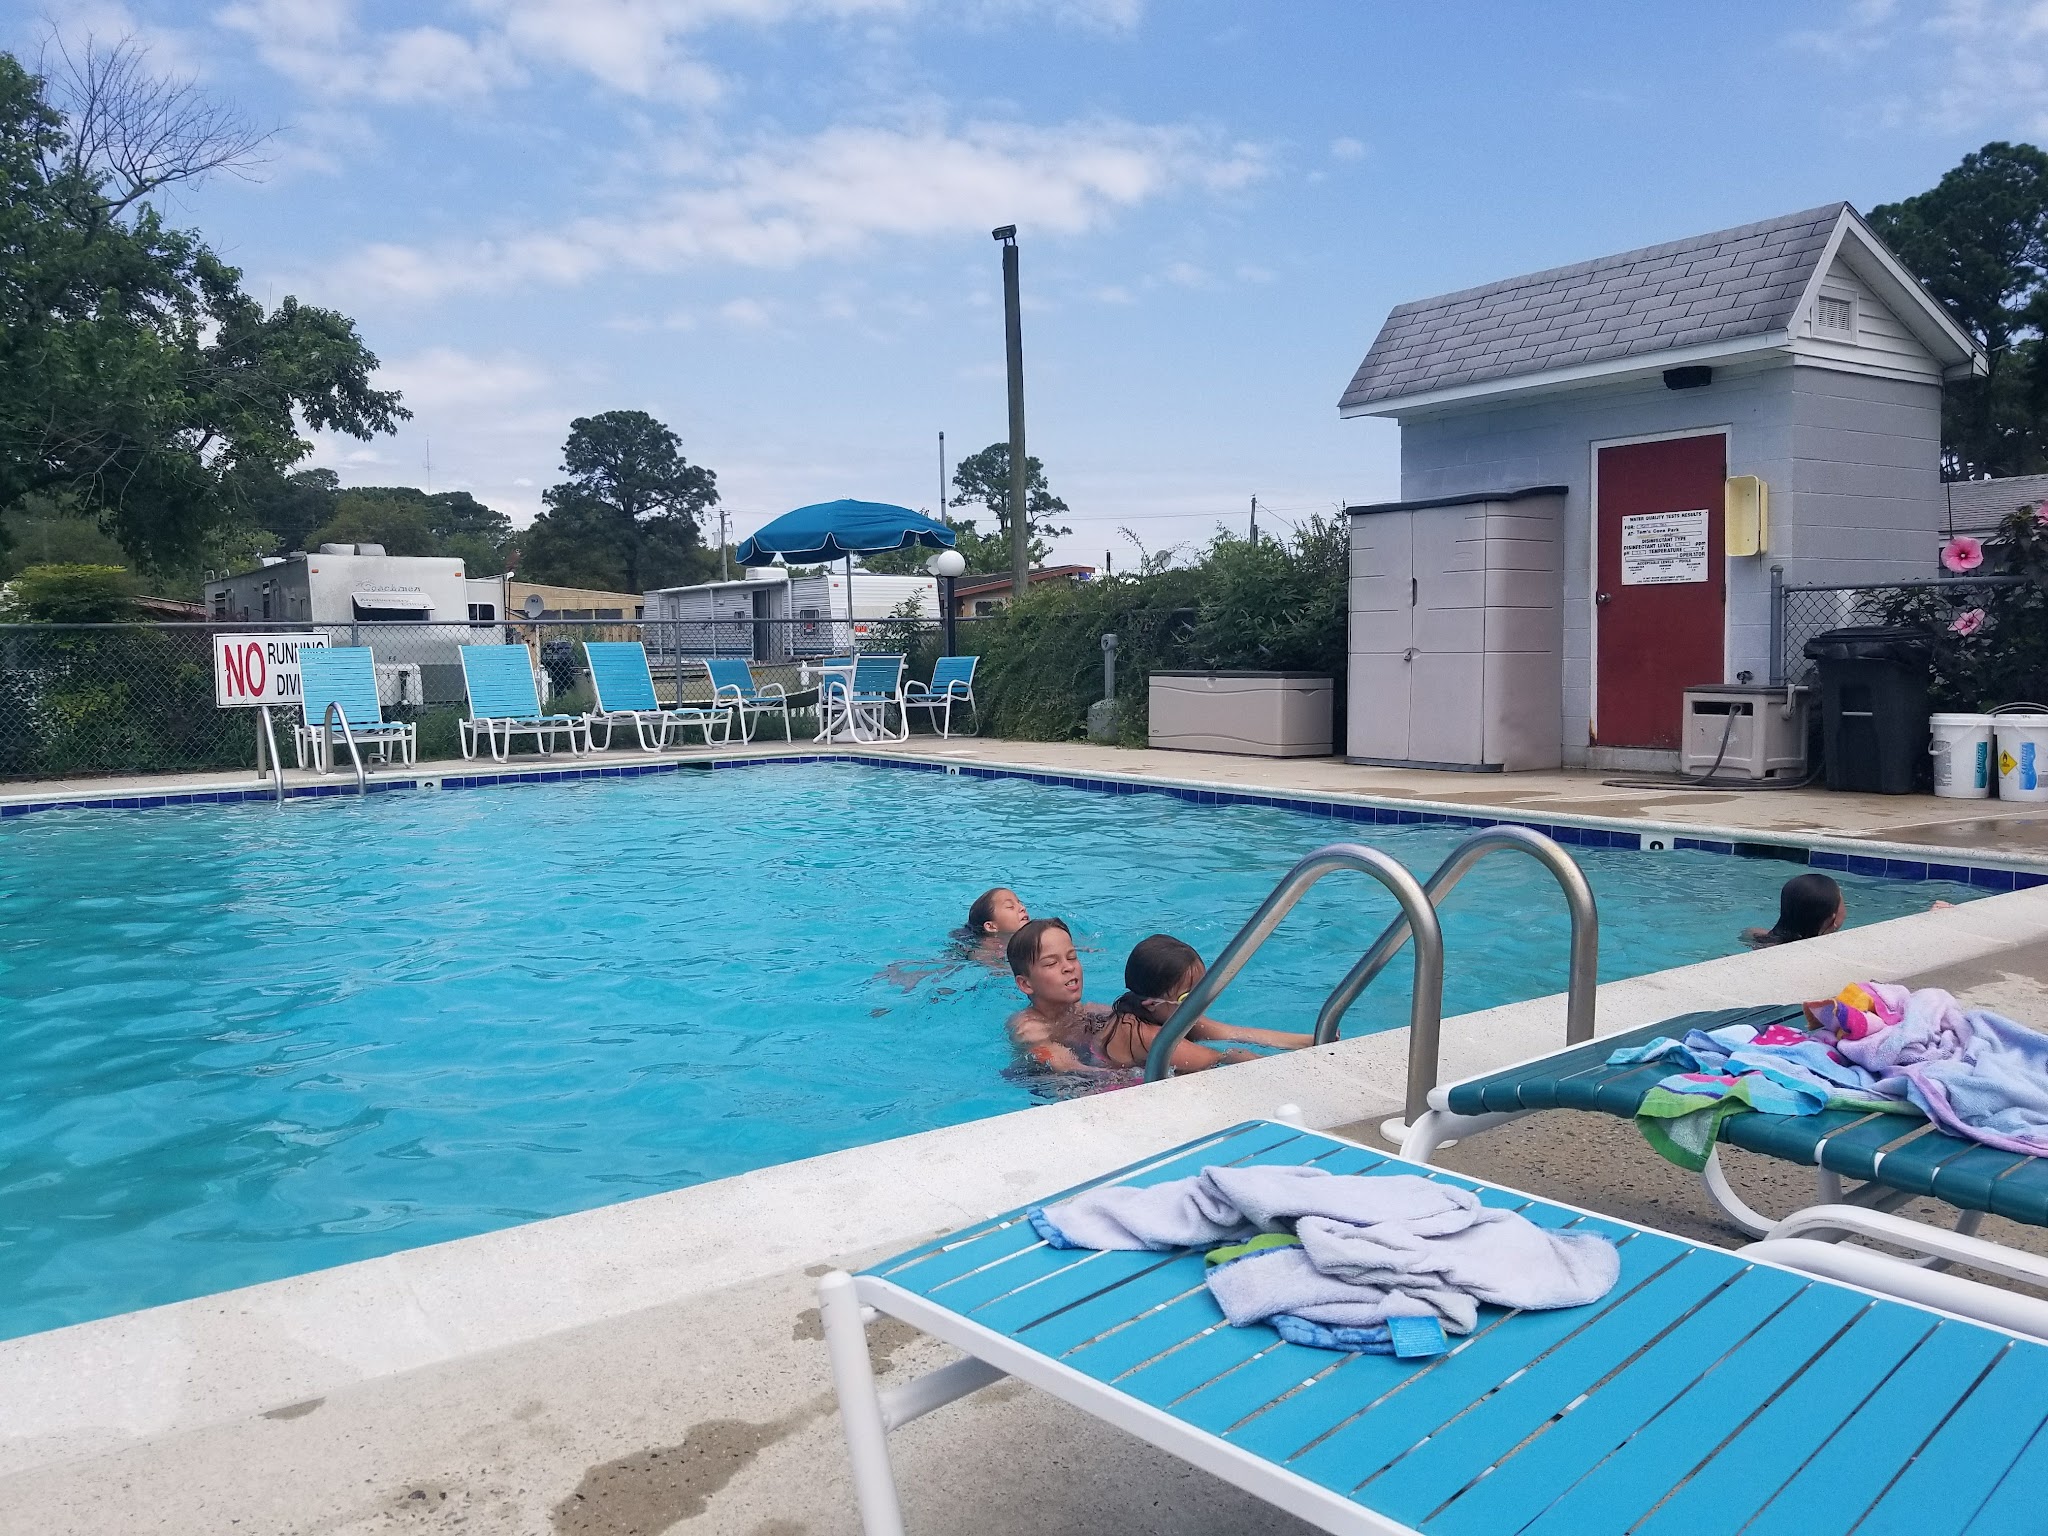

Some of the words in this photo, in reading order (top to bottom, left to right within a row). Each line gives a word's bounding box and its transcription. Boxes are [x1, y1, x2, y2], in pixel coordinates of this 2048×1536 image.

[361, 582, 421, 592] Coachmen
[224, 642, 266, 697] NO
[277, 674, 300, 696] DIVI
